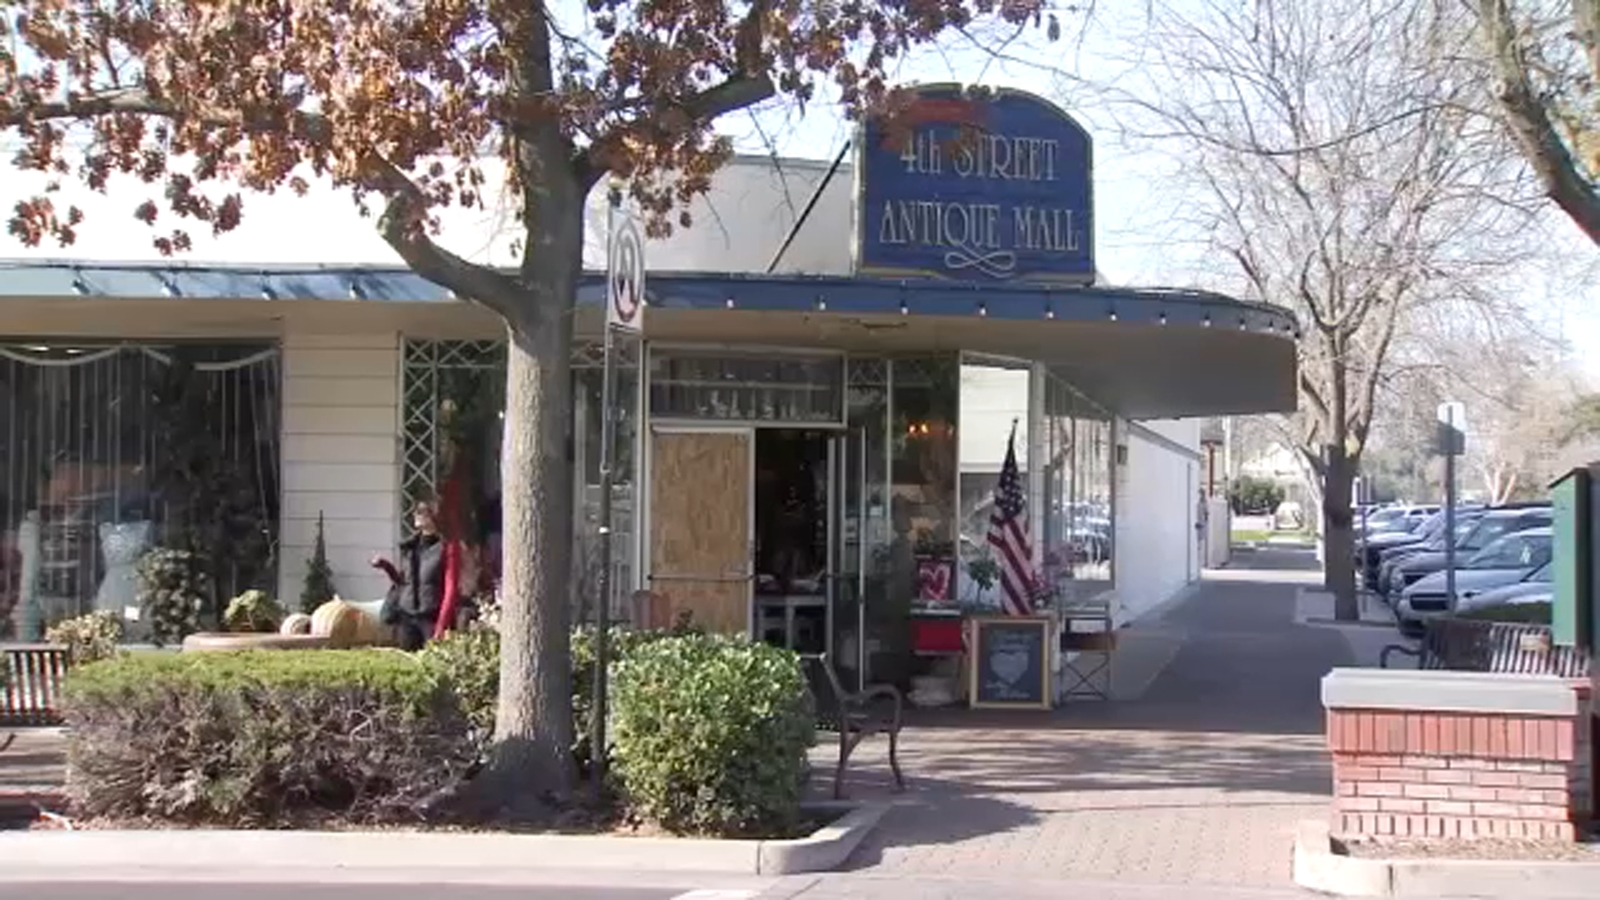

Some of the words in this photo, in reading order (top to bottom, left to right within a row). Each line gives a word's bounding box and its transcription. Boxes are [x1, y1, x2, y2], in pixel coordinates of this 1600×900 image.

[900, 130, 942, 174] 4th
[953, 134, 1059, 181] STREET
[879, 196, 1001, 250] ANTIQUE
[1012, 206, 1081, 252] MALL
